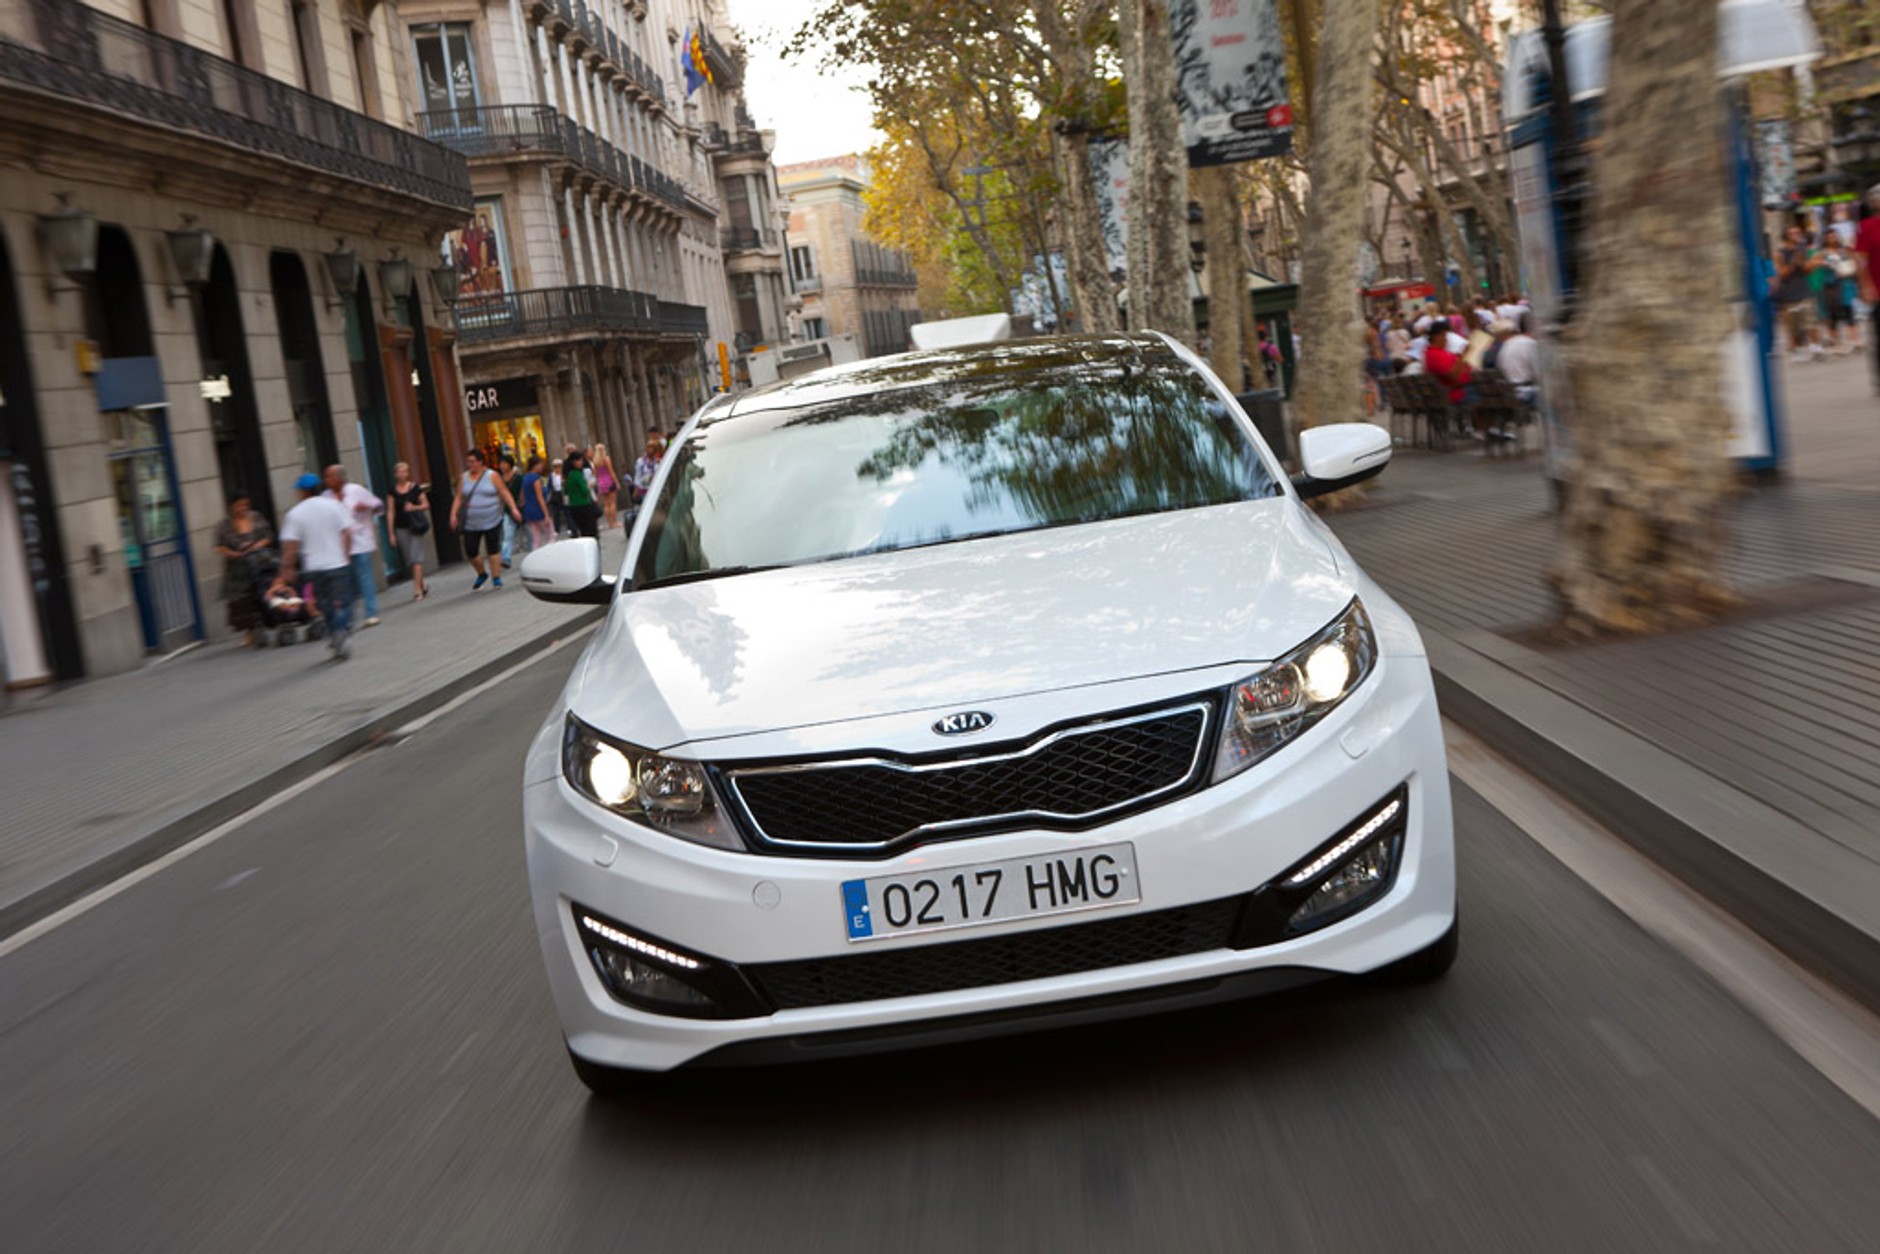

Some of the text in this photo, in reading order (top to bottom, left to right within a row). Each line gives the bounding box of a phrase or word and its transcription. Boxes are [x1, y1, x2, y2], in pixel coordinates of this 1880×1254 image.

[466, 387, 499, 411] GAR
[942, 712, 986, 732] KIA
[883, 854, 1120, 928] 0217 HMG
[853, 915, 865, 929] E
